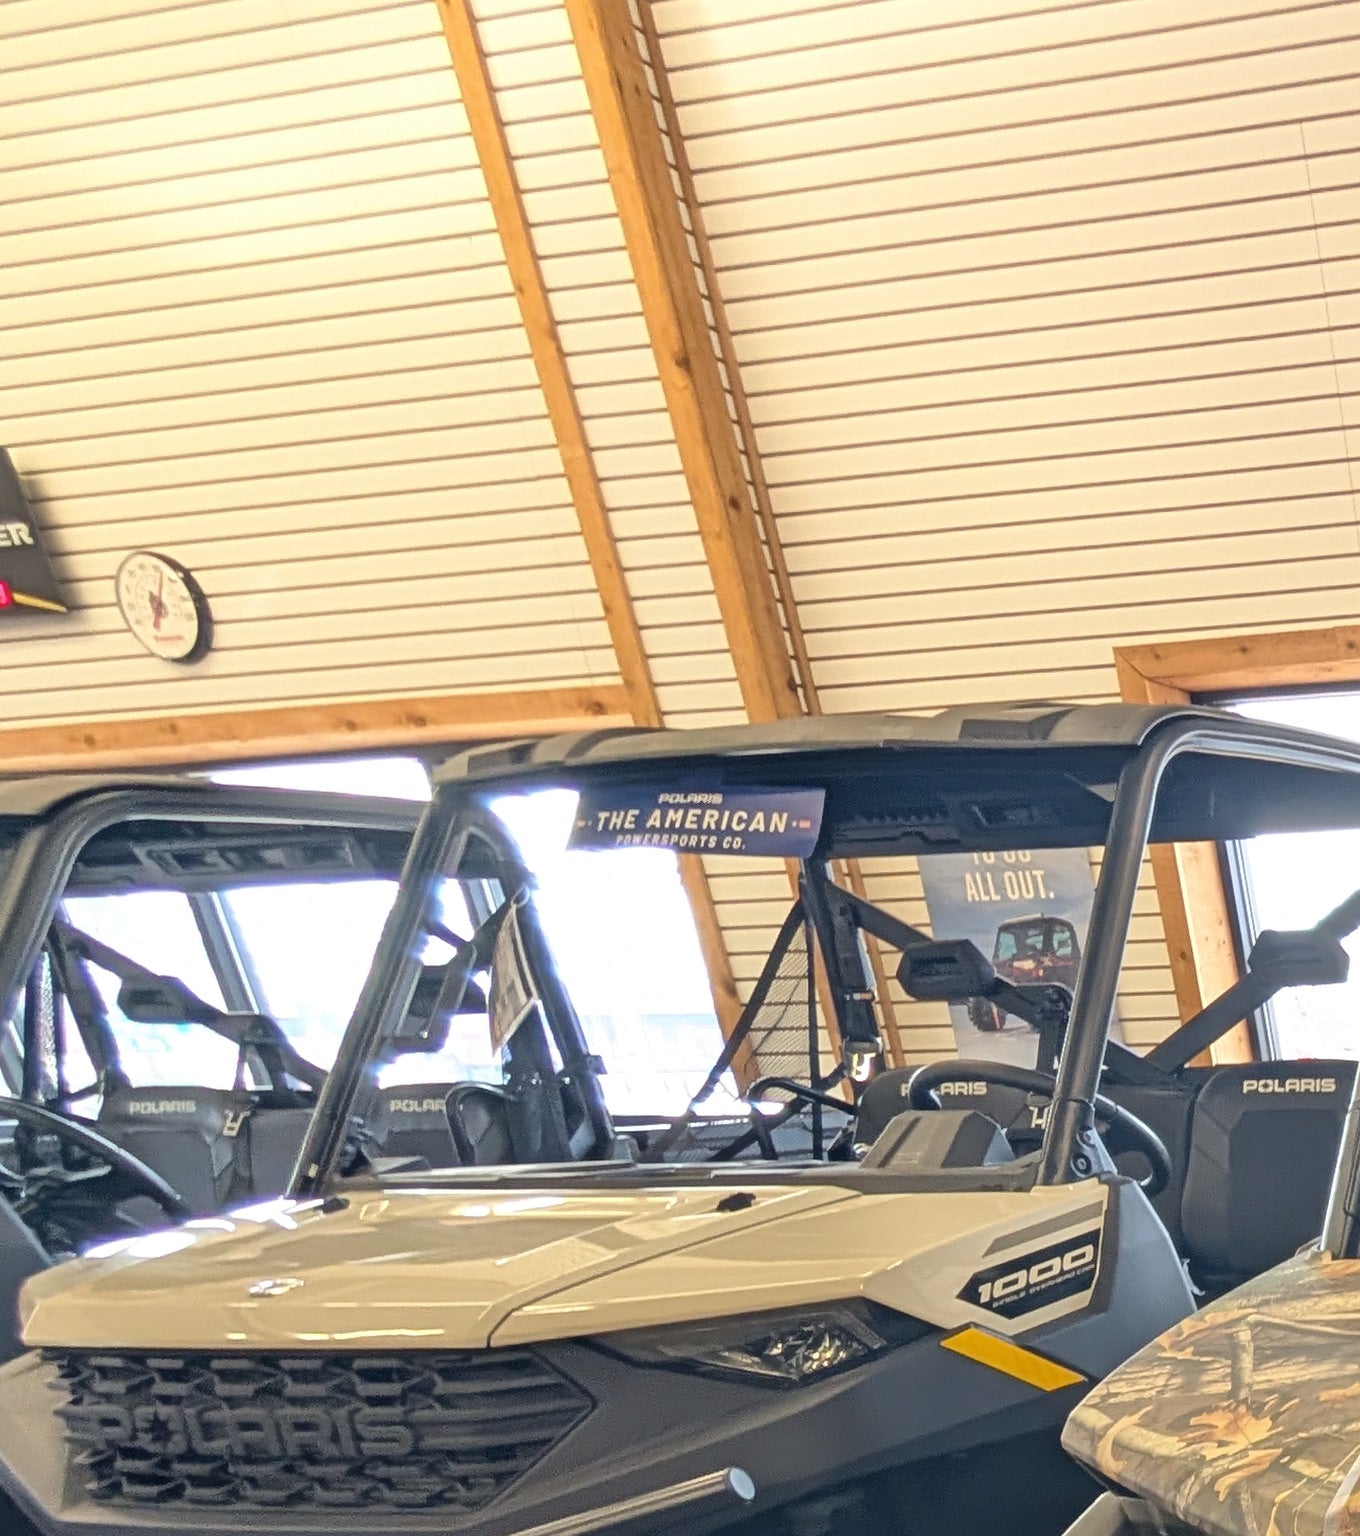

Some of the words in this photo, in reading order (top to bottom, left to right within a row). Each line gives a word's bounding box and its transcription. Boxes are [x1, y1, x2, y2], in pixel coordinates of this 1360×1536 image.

[658, 793, 723, 804] POLARIS
[597, 809, 640, 832] THE
[646, 808, 788, 833] AMERICAN
[616, 834, 717, 848] POWERSPORTS
[722, 837, 746, 850] CO.
[965, 872, 1001, 902] ALL
[1003, 869, 1055, 901] OUT.
[901, 1081, 987, 1097] PARIS
[1242, 1077, 1337, 1094] POLARIS
[978, 1243, 1094, 1305] 1000
[92, 1402, 414, 1457] POLARIS
